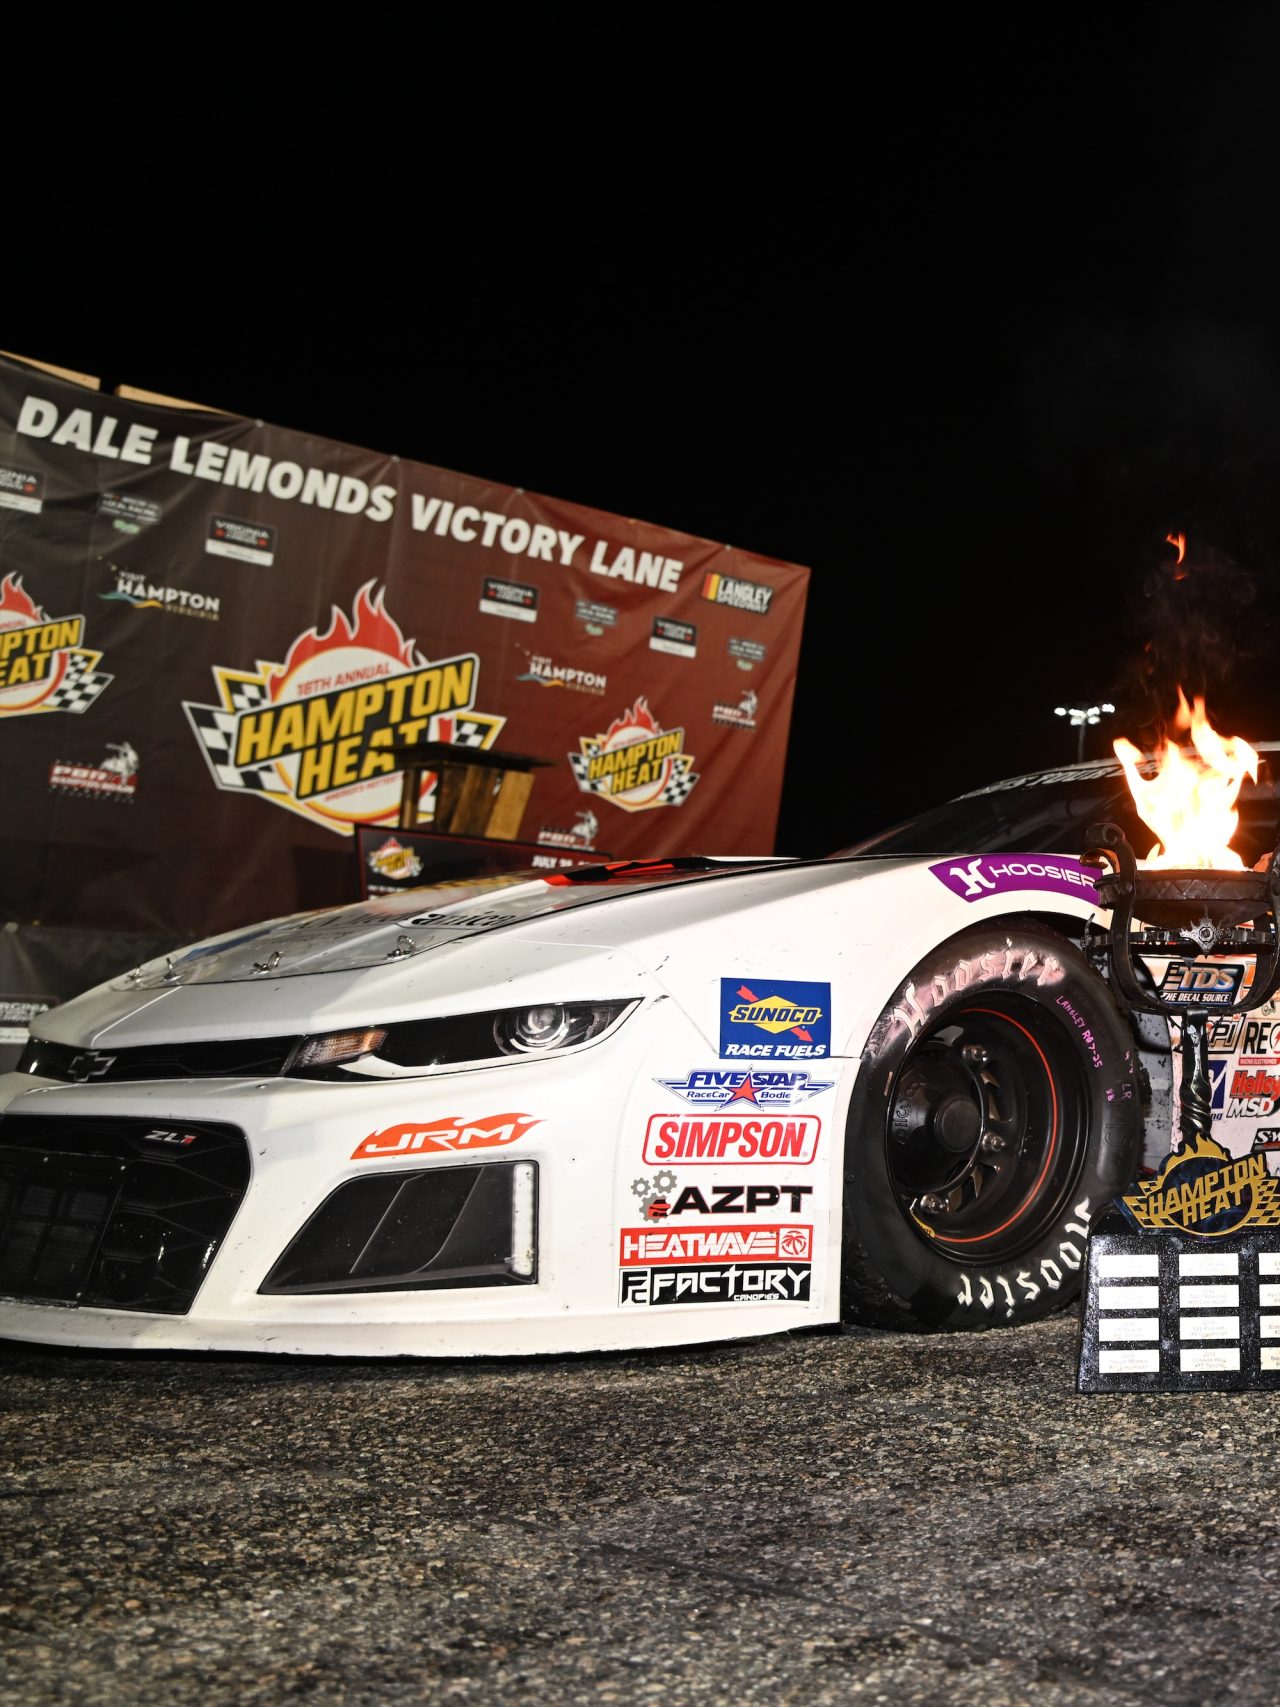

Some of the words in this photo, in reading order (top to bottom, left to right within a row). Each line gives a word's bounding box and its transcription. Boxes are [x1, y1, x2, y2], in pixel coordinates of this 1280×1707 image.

[16, 396, 159, 466] DALE
[169, 435, 398, 522] LEMONDS
[411, 493, 586, 567] VICTORY
[589, 539, 685, 593] LANE
[117, 578, 221, 612] HAMPTON
[718, 577, 773, 606] LANGLEY
[0, 619, 81, 661] PTON
[0, 651, 51, 688] EAT
[335, 662, 391, 686] ANNUAL
[530, 661, 607, 689] HAMPTON
[235, 657, 474, 767] HAMPTON
[299, 717, 428, 797] HEAT
[589, 731, 681, 780] HAMPTON
[612, 759, 663, 795] HEAT
[990, 863, 1098, 891] HOOSIER
[1179, 966, 1240, 992] TDS
[1056, 995, 1086, 1028] LANGLEY
[1160, 992, 1177, 1002] THE
[1178, 992, 1202, 1002] DECAL
[1201, 992, 1230, 1002] SOURCE
[732, 1006, 819, 1024] SUNOCO
[724, 1043, 774, 1057] RACE
[775, 1043, 827, 1057] FUELS
[686, 1090, 731, 1099] RaceCar
[760, 1090, 791, 1099] Bodie
[687, 1071, 746, 1089] FIVE
[1226, 1097, 1276, 1119] MSD
[364, 1123, 517, 1152] JRM
[654, 1120, 808, 1159] SIMPSON
[1149, 1153, 1267, 1216] HAMPTON
[668, 1185, 814, 1215] AZPT
[1182, 1180, 1245, 1228] HEAT
[623, 1231, 777, 1260] HEATWAVE
[652, 1264, 812, 1302] FACTORY
[733, 1292, 780, 1302] CANOPIES
